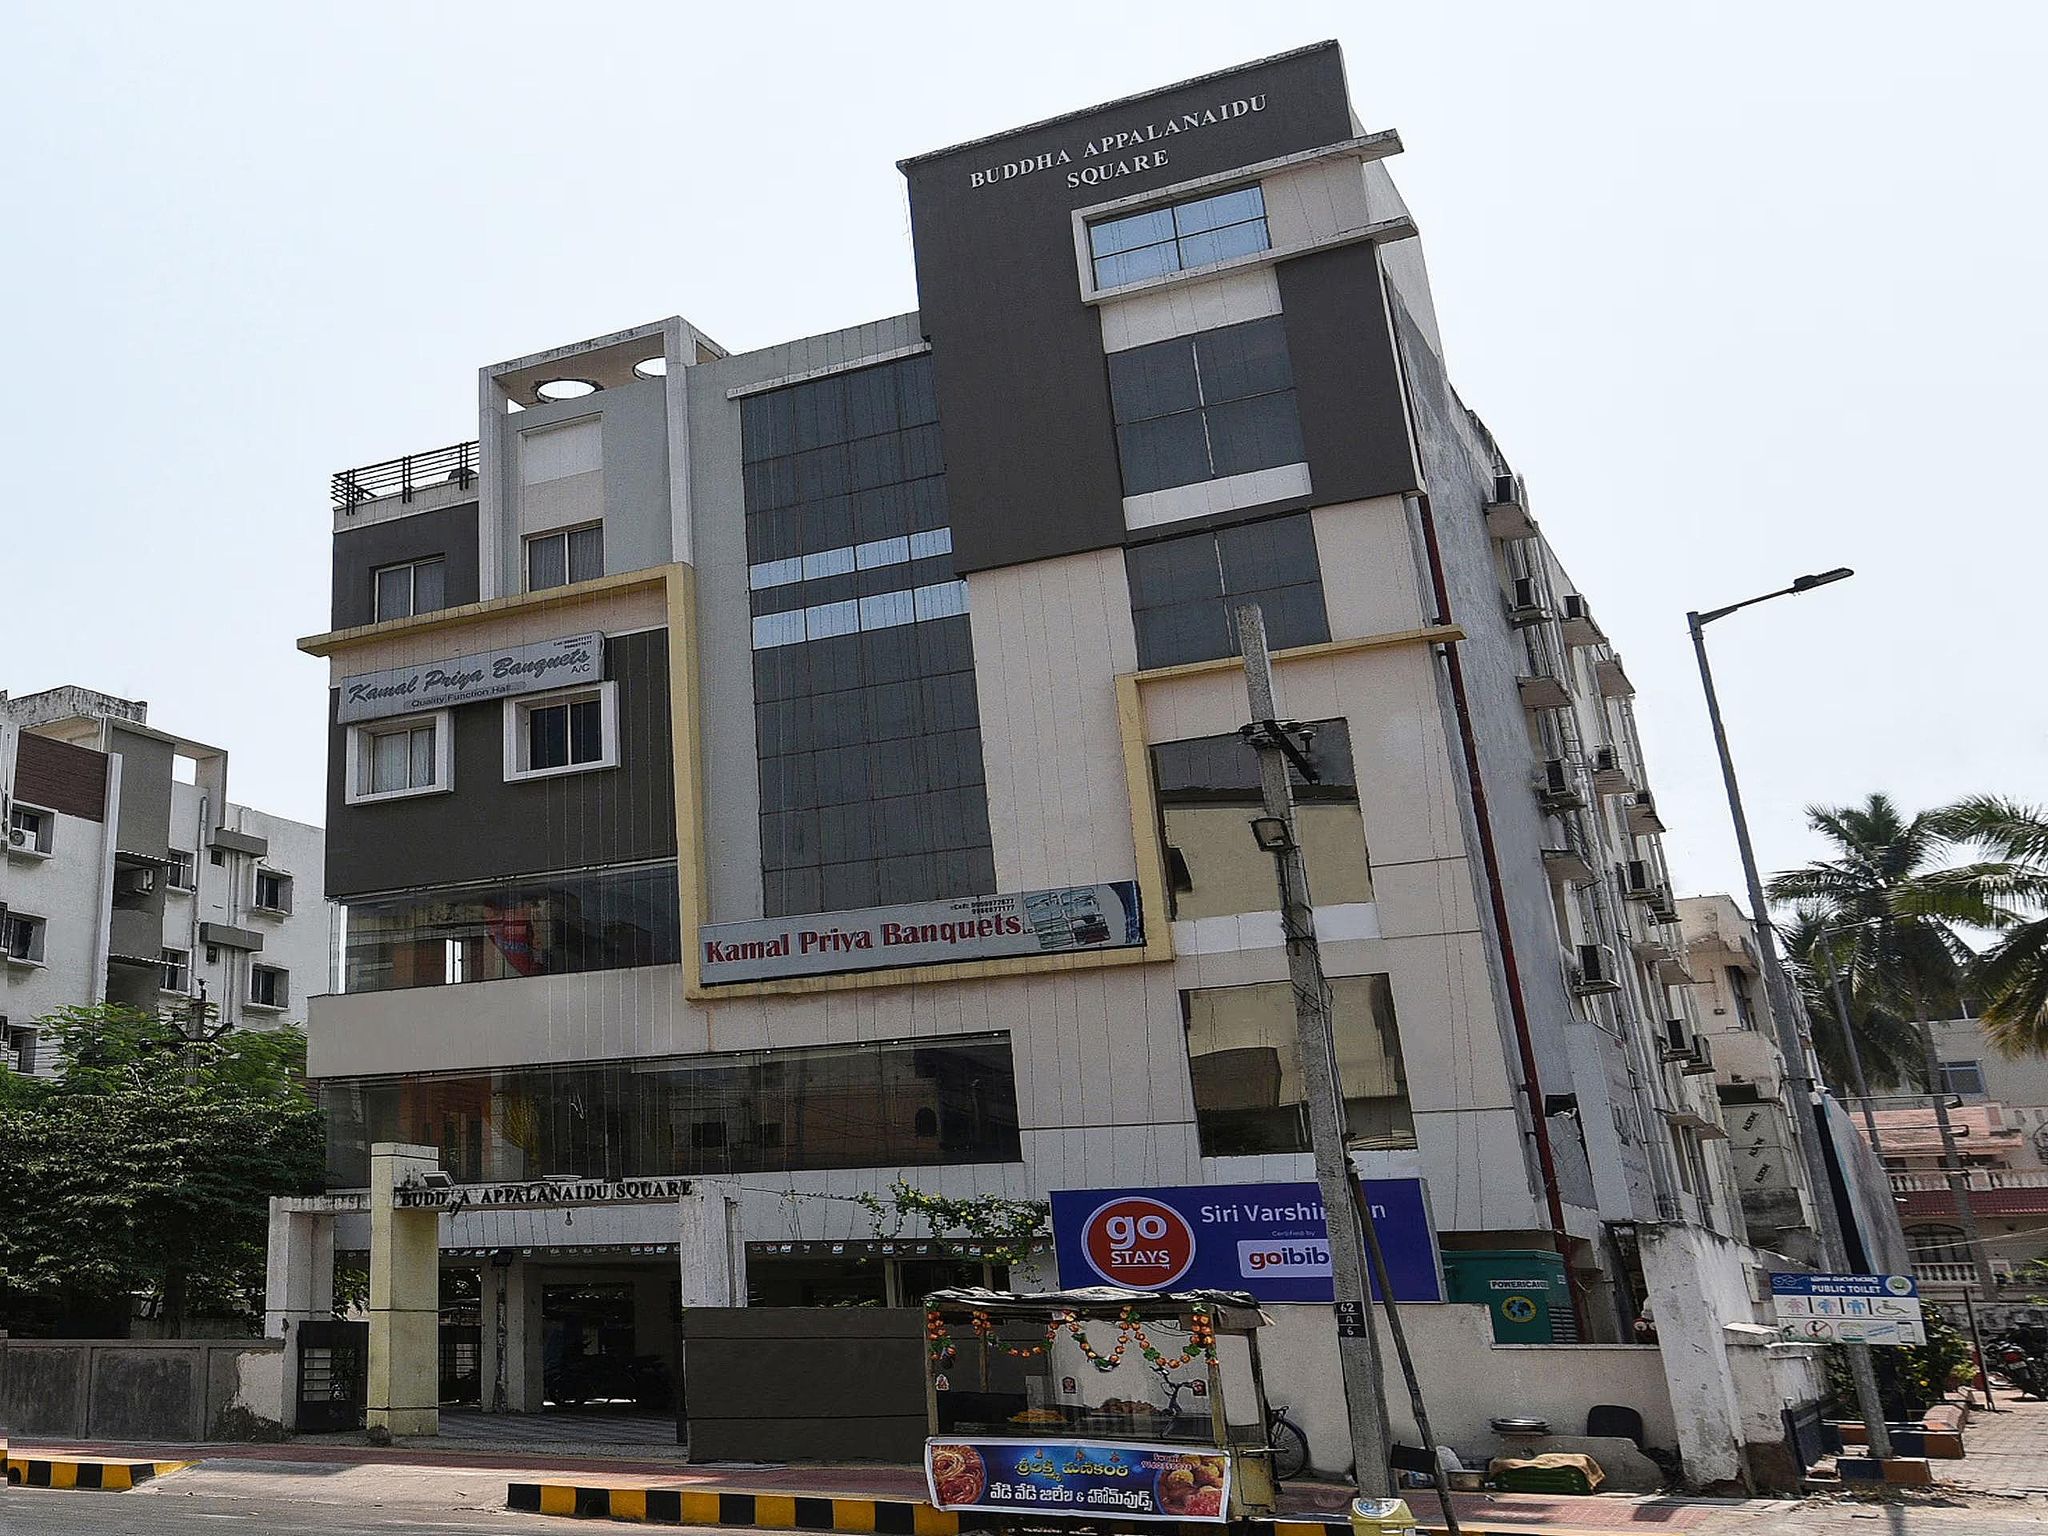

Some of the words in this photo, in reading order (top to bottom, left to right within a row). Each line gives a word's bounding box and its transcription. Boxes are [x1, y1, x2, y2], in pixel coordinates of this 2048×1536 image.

[970, 149, 1072, 189] BUDDHA
[1083, 94, 1268, 159] APPALANAIDU
[1066, 149, 1169, 190] SQUARE
[348, 676, 418, 704] Kamal
[423, 669, 485, 692] Priya
[492, 649, 590, 679] Banquets
[447, 688, 489, 702] Function
[704, 933, 790, 963] Kamal
[798, 928, 873, 954] Priya
[882, 912, 1021, 946] Banquets
[481, 1182, 609, 1204] APPALANAIDU
[615, 1179, 692, 1200] SQUARE
[1201, 1204, 1239, 1223] Siri
[1244, 1202, 1325, 1222] Varshi
[1106, 1215, 1167, 1250] go
[1111, 1250, 1169, 1264] STAYS
[1249, 1246, 1331, 1270] goibib
[1811, 1285, 1846, 1294] PUBLIC
[1848, 1285, 1881, 1295] TOILET
[1340, 1303, 1355, 1312] 62
[1346, 1316, 1353, 1324] A
[1347, 1326, 1354, 1335] 6
[990, 1482, 1012, 1500] వేడి
[1014, 1483, 1037, 1501] వేడి
[1076, 1491, 1085, 1503] &
